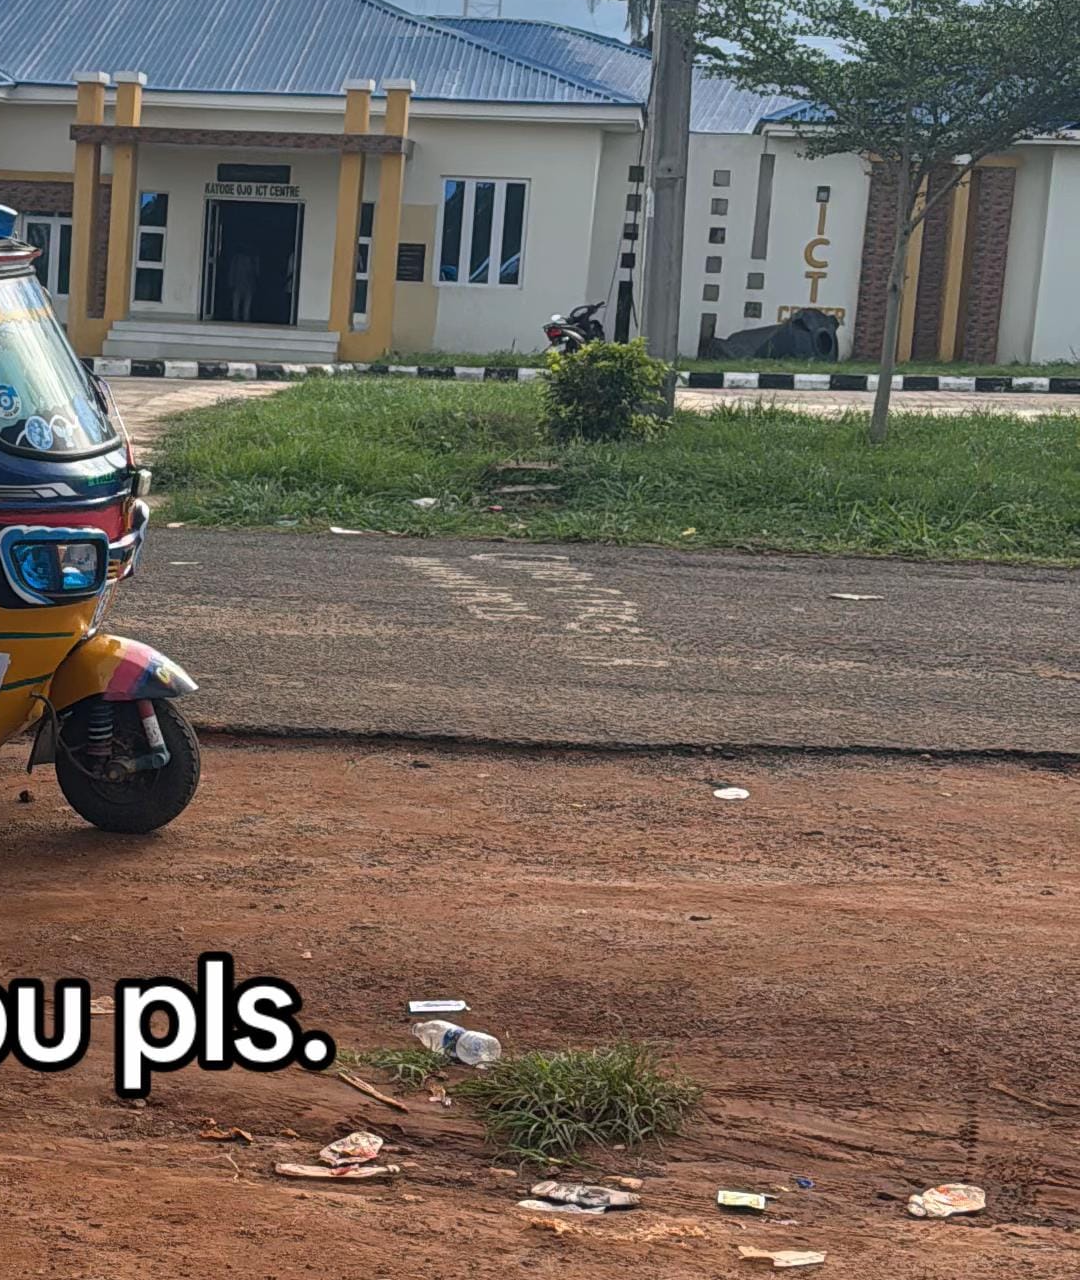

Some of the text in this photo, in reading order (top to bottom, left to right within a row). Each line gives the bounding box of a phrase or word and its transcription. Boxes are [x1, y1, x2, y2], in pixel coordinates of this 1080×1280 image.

[236, 184, 253, 197] OJO
[255, 185, 268, 197] ICT
[269, 185, 301, 198] CENTRE
